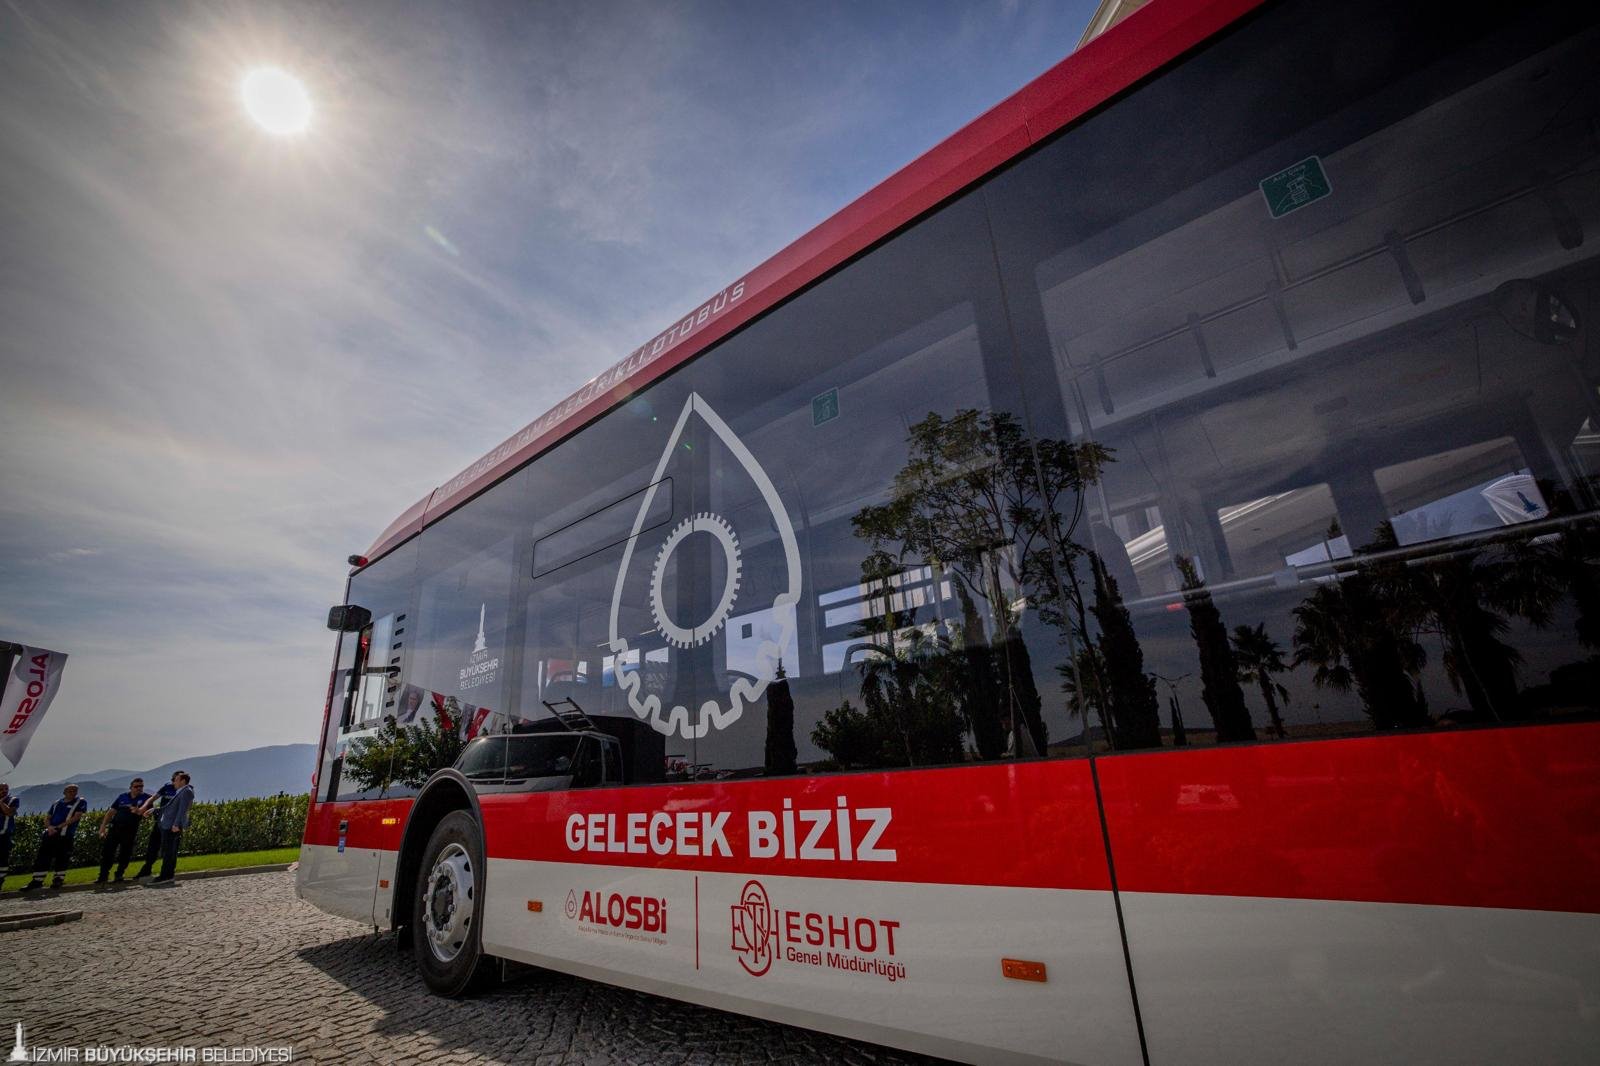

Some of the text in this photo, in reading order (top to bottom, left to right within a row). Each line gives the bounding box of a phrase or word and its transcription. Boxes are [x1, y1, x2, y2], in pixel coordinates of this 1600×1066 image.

[651, 282, 745, 355] OTOBÜS
[565, 796, 897, 862] GELECEK BİZİZ
[785, 911, 900, 956] ESHOT
[786, 946, 906, 982] Genel Müdürlüğü
